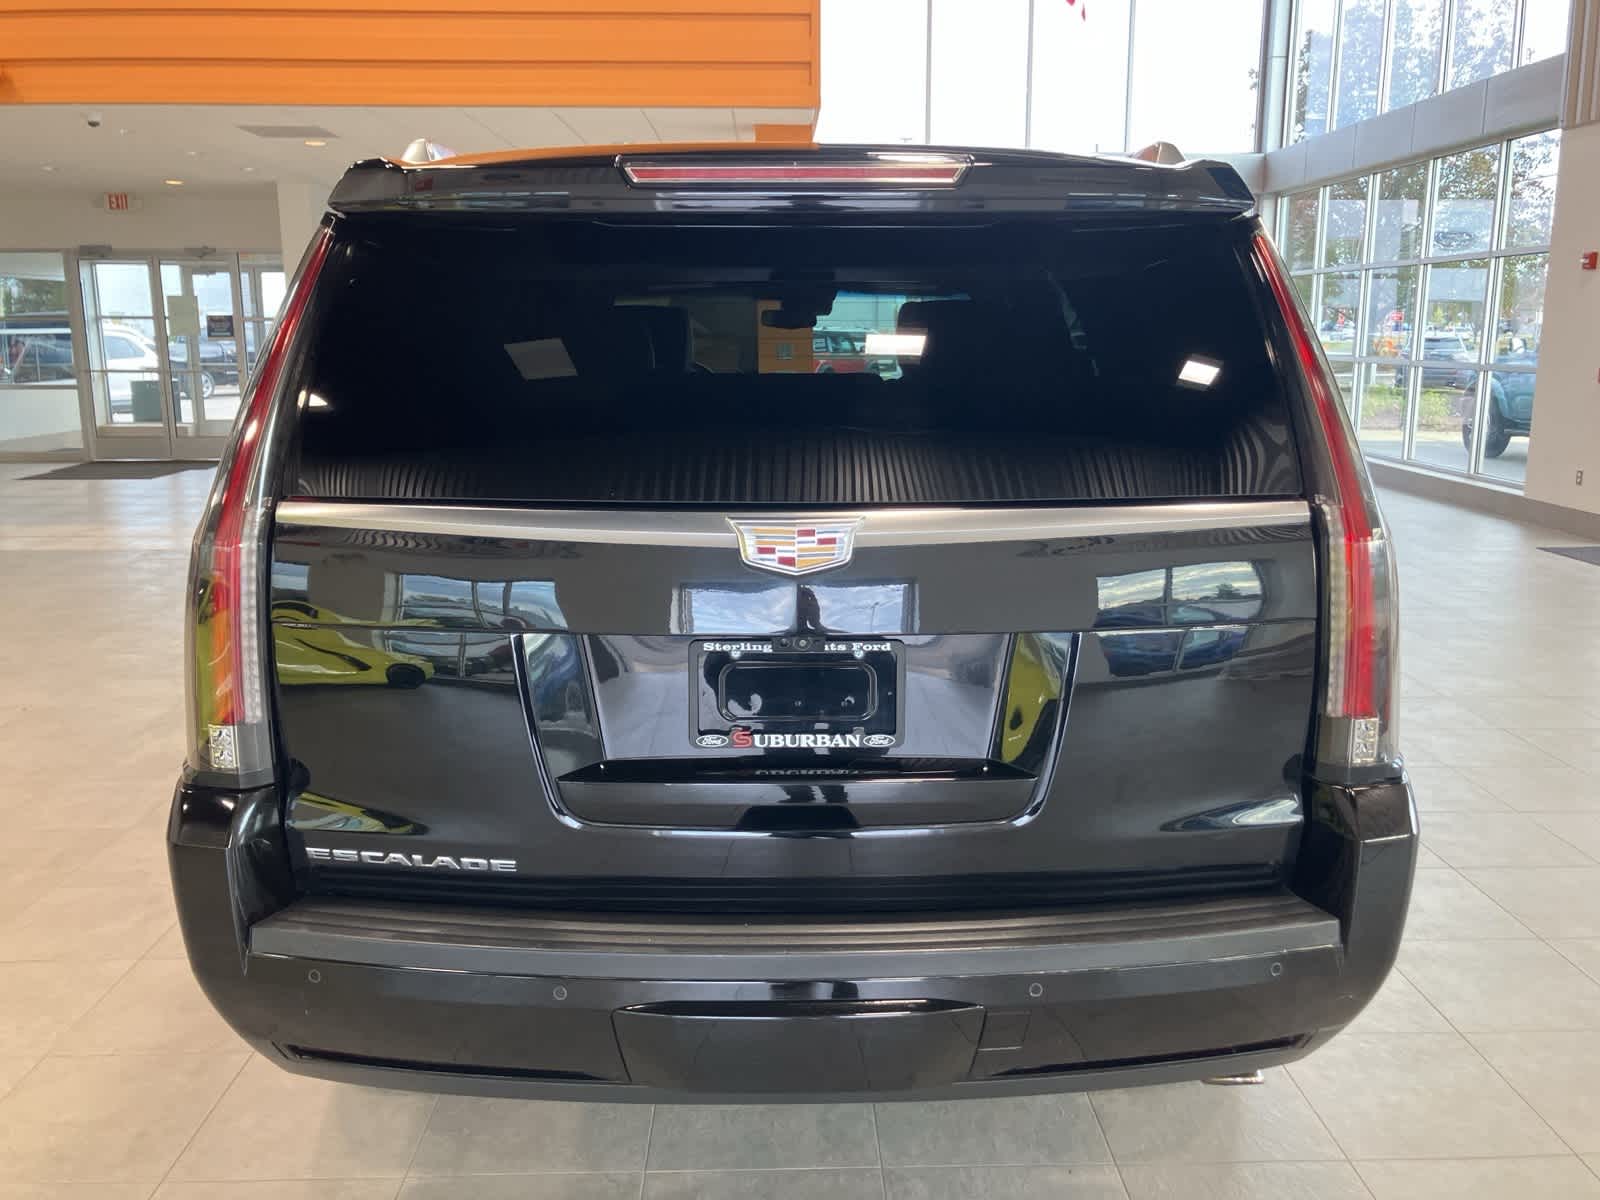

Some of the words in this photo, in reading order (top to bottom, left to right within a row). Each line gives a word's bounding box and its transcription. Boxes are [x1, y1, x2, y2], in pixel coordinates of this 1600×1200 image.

[107, 192, 129, 210] EXIT
[703, 642, 773, 653] Sterling
[852, 642, 892, 652] Ford
[733, 730, 861, 748] SUBURBAN
[305, 847, 518, 872] ESCALADE
